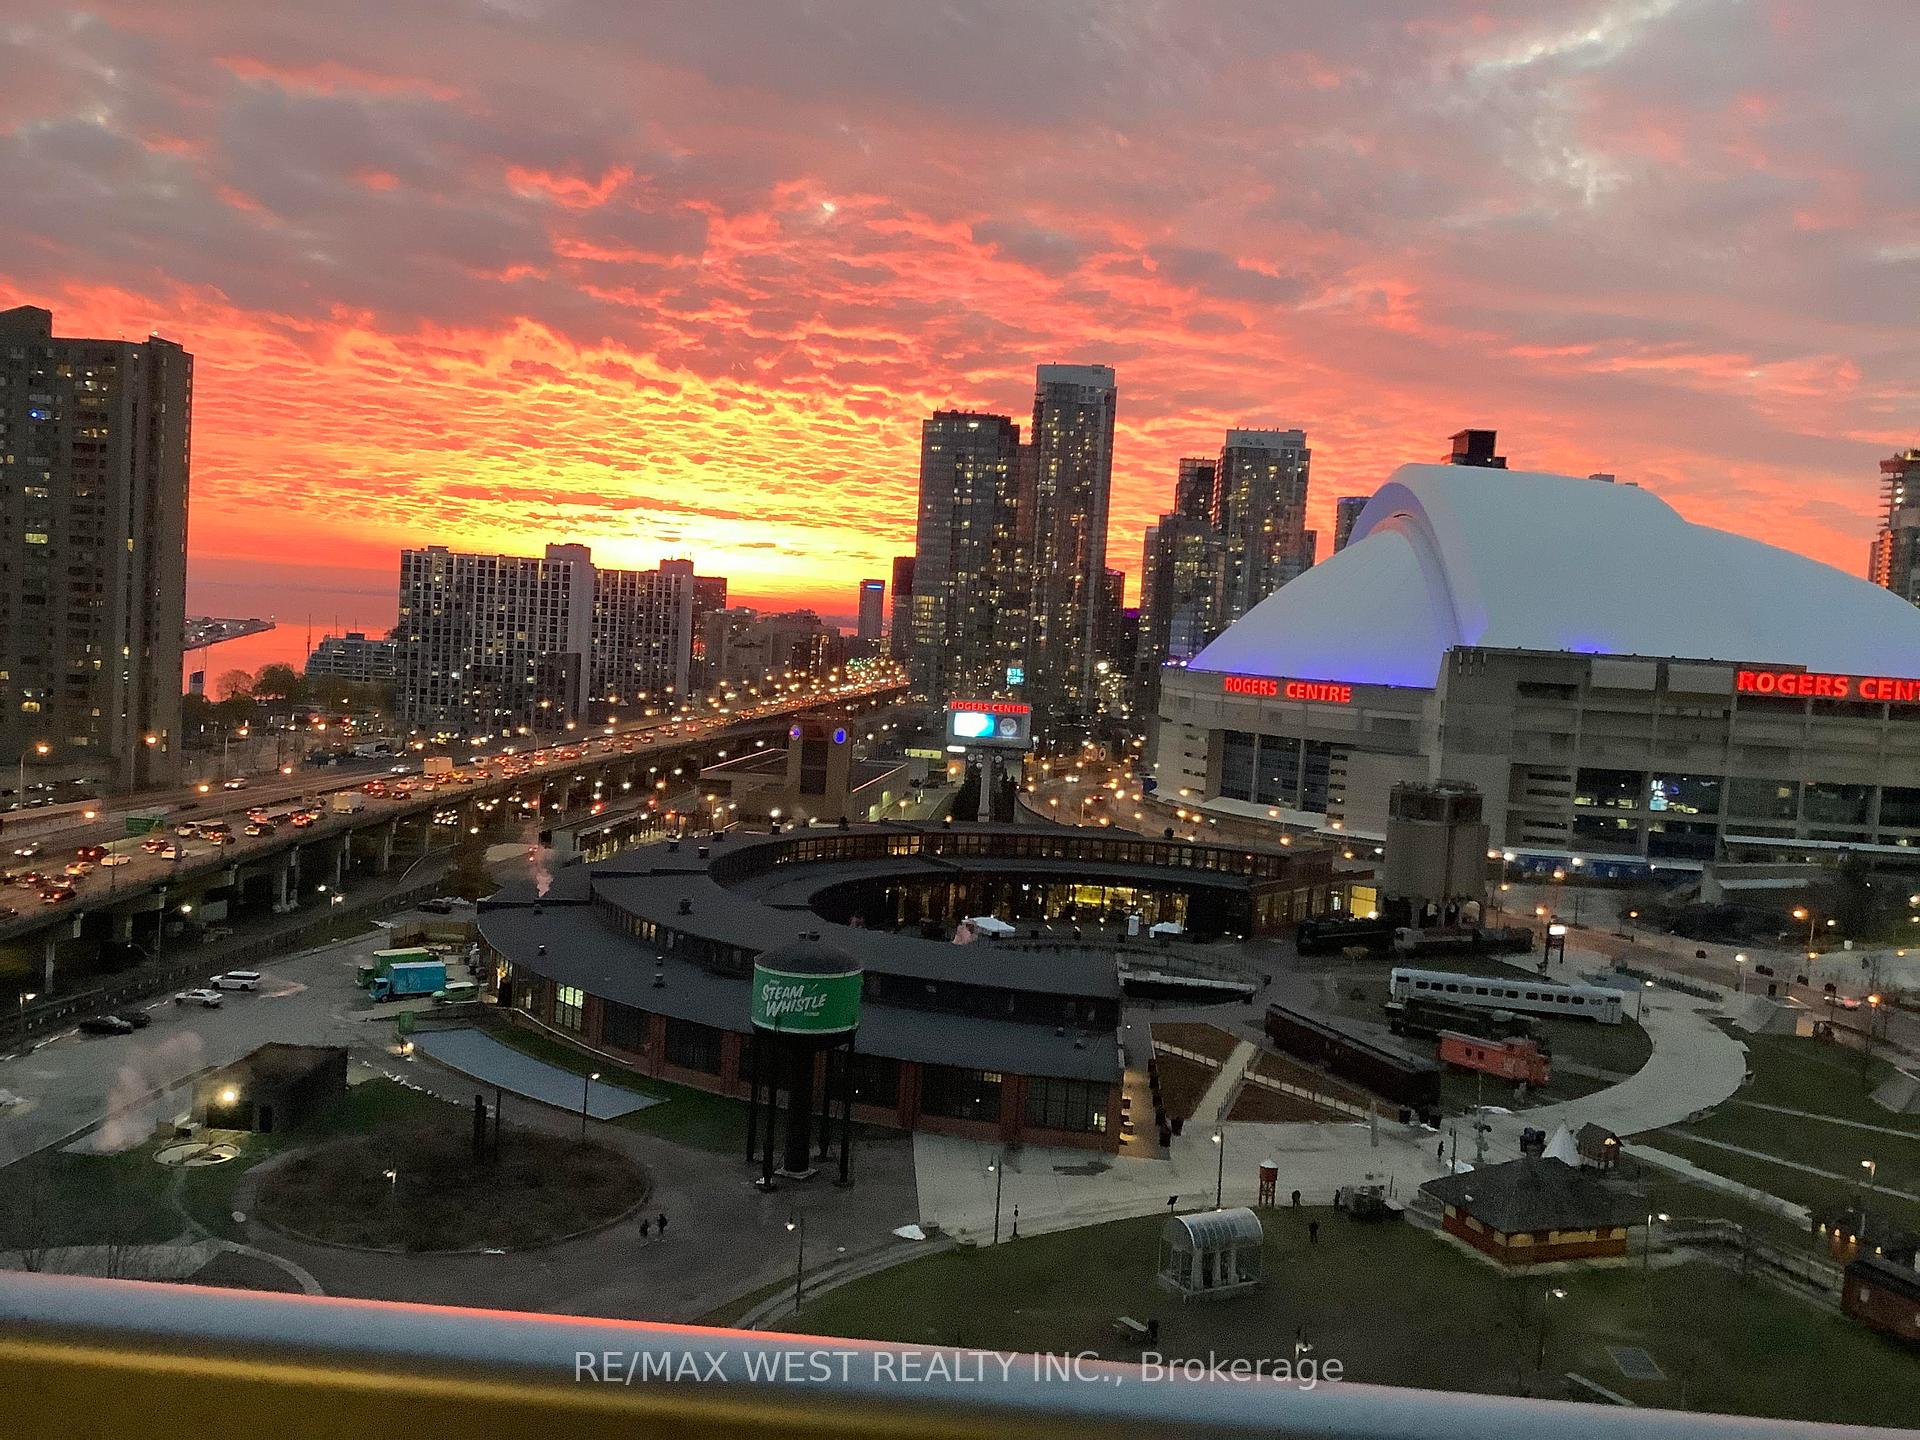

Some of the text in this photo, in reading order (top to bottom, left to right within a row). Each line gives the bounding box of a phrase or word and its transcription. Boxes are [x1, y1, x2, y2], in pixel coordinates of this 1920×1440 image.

[1224, 677, 1352, 703] ROGERS CENTRE
[1737, 671, 1849, 697] ROGERS
[951, 702, 1029, 714] ROGERS CENTRE
[761, 984, 805, 1001] STEAM
[766, 993, 828, 1018] WHISTLE
